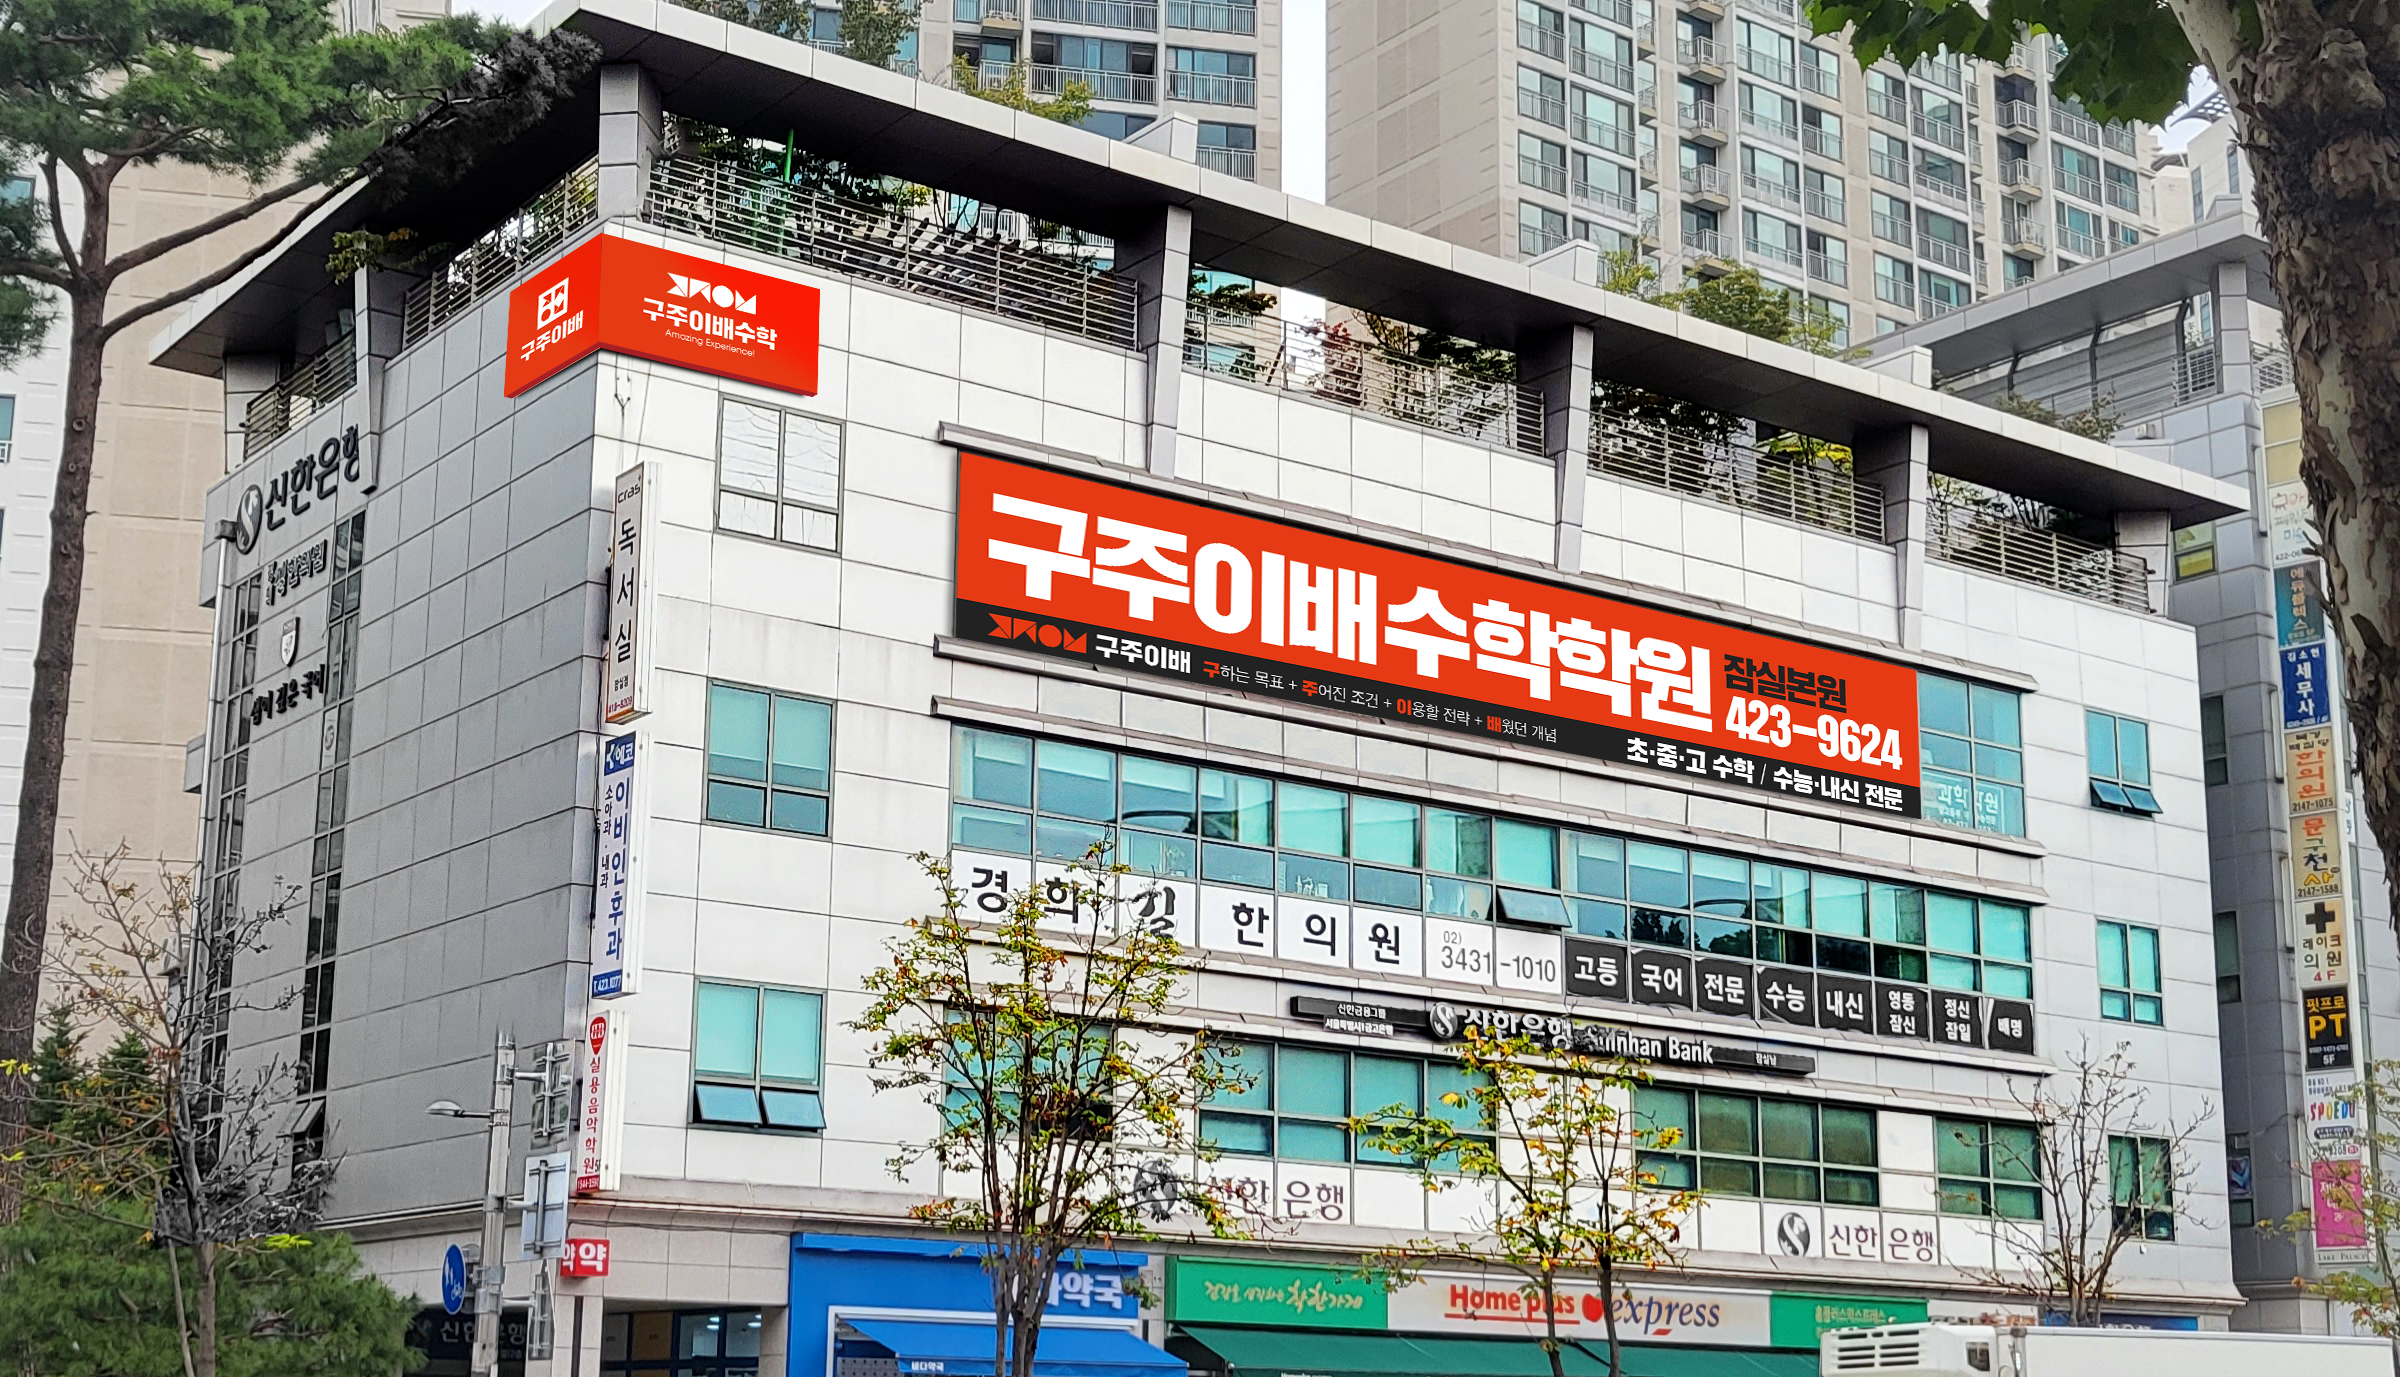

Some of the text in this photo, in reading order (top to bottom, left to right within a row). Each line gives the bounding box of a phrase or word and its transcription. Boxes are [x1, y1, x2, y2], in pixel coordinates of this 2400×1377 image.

[520, 310, 584, 361] 구주이배
[643, 297, 777, 351] 구주이배수학
[665, 328, 756, 357] Amazing Experience!
[265, 424, 359, 531] 신한은행
[614, 517, 637, 663] 독서실
[988, 492, 1713, 732] 구주이배수학학원
[1095, 634, 1191, 674] 구주이배
[1203, 660, 1250, 684] 구하는
[1255, 670, 1284, 691] 목표
[1301, 679, 1346, 703] 주어진
[1351, 689, 1380, 711] 조건
[1396, 698, 1440, 721] 이용할
[1443, 705, 1470, 727] 전략
[1486, 714, 1528, 738] 배웠던
[1531, 723, 1557, 744] 개념
[1723, 652, 1847, 713] 잠실본원
[2295, 661, 2315, 716] 세무사
[1725, 695, 1903, 771] 423-9624
[1626, 736, 1707, 776] 초·중·고
[1712, 756, 1755, 785] 수학
[1773, 765, 1861, 806] 수능·내신
[1864, 783, 1903, 812] 전문
[2296, 750, 2327, 799] 한의원
[606, 777, 630, 961] 이비인후과
[971, 867, 1080, 924] 경희
[1232, 902, 1400, 965] 한의원
[1443, 931, 1463, 945] 02)
[2303, 935, 2342, 950] 레이크
[2304, 951, 2342, 969] 의원
[1574, 954, 2023, 1038] 고등 국어 전문 수능 내신 영동 정신 배명
[2306, 996, 2346, 1013] 핏프로
[1463, 1008, 1574, 1051] 신한은행
[1667, 1035, 1714, 1065] Bank
[1888, 1014, 1971, 1044] 잠신 잠일
[2309, 1013, 2347, 1041] PT
[2322, 1054, 2335, 1066] 5F
[583, 1056, 601, 1174] 실용음악학원
[2310, 1101, 2355, 1121] SPOEDU
[579, 1242, 607, 1273] 약
[1829, 1224, 1934, 1262] 신한은행
[440, 1320, 525, 1345] 신한행
[1449, 1283, 1521, 1311] Home
[1612, 1295, 1721, 1335] express
